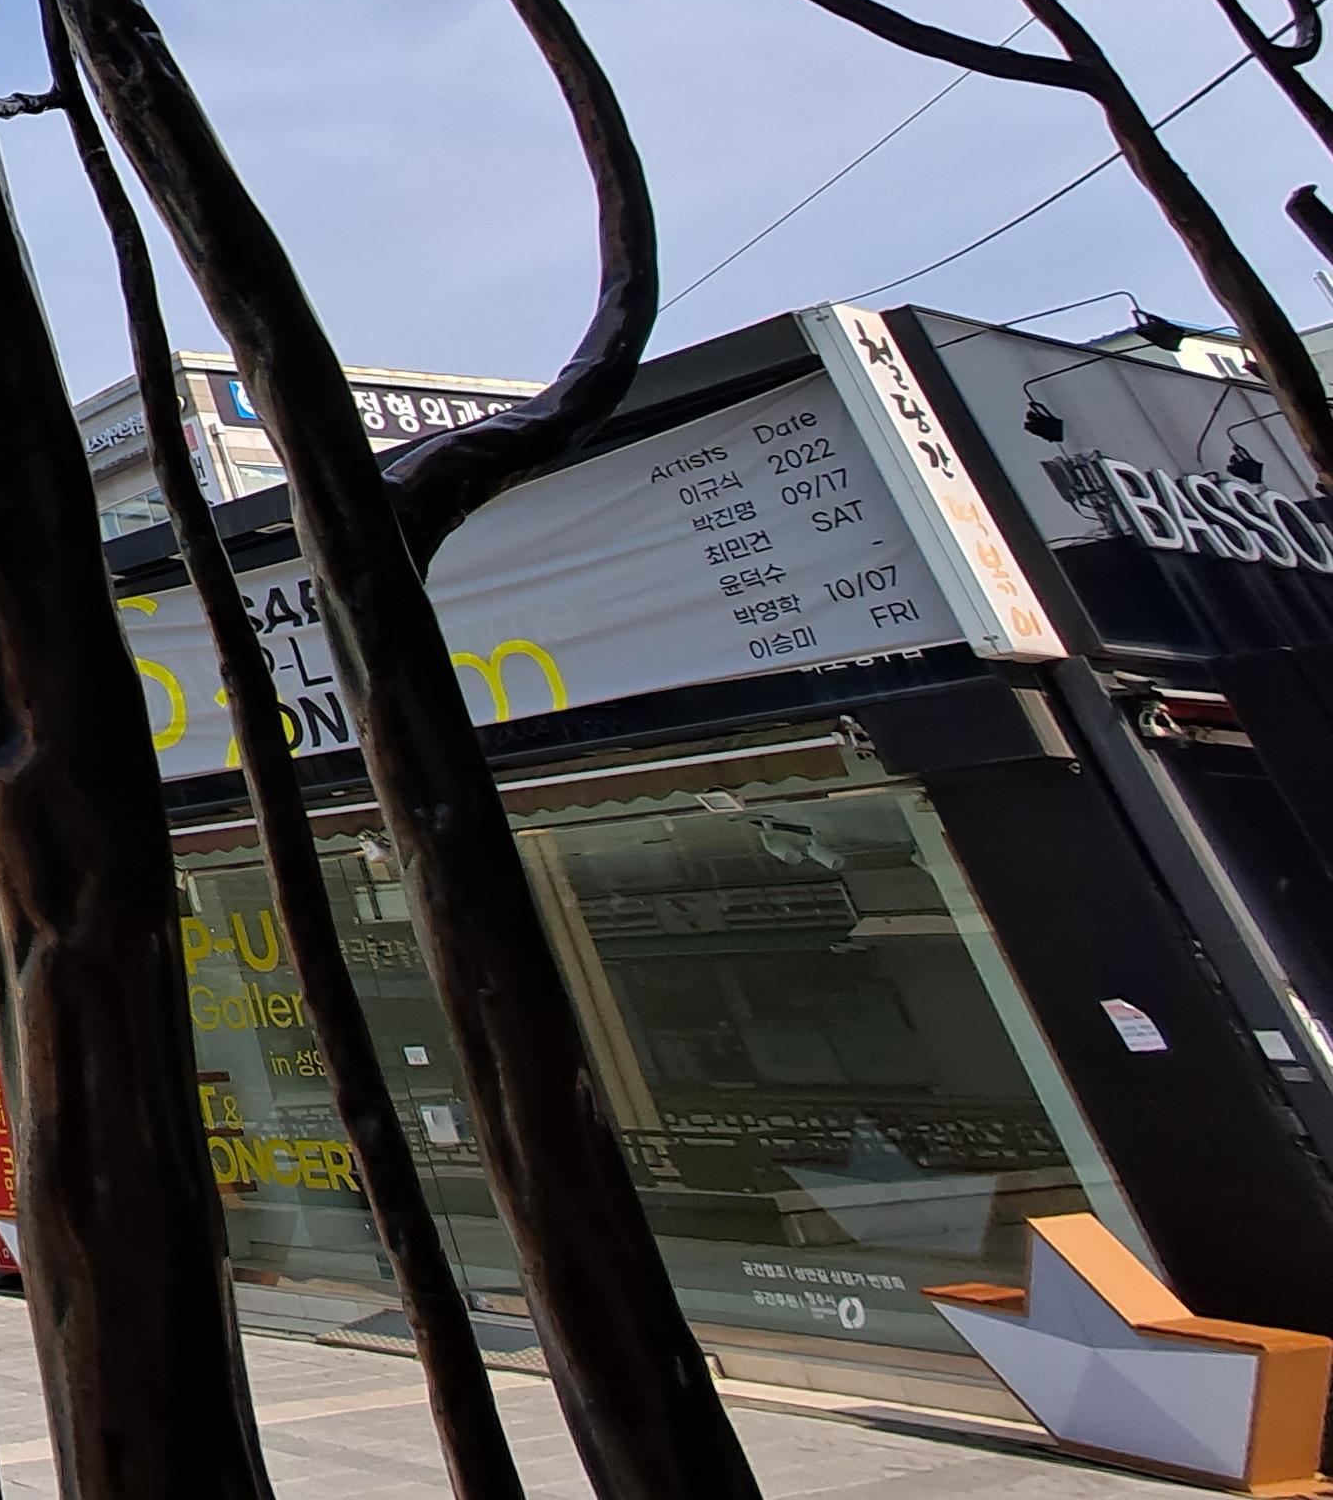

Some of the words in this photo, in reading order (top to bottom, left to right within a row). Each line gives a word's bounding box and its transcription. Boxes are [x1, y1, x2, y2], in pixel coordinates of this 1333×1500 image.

[751, 412, 818, 445] Date
[650, 445, 729, 484] Artists
[767, 437, 836, 475] 2022
[679, 469, 744, 506] 이규식
[781, 467, 848, 506] 09/17
[691, 500, 757, 532] 박진명
[810, 499, 865, 533] SAT
[1102, 456, 1333, 574] BASSO
[704, 529, 773, 566] 최민건
[719, 563, 787, 597] 윤덕수
[823, 564, 897, 603] 10/07
[733, 593, 802, 626] 박영학
[869, 599, 921, 629] FRI
[748, 625, 818, 660] 이승미
[188, 982, 306, 1031] Galler
[269, 1050, 292, 1077] in
[207, 1136, 361, 1193] ONCER
